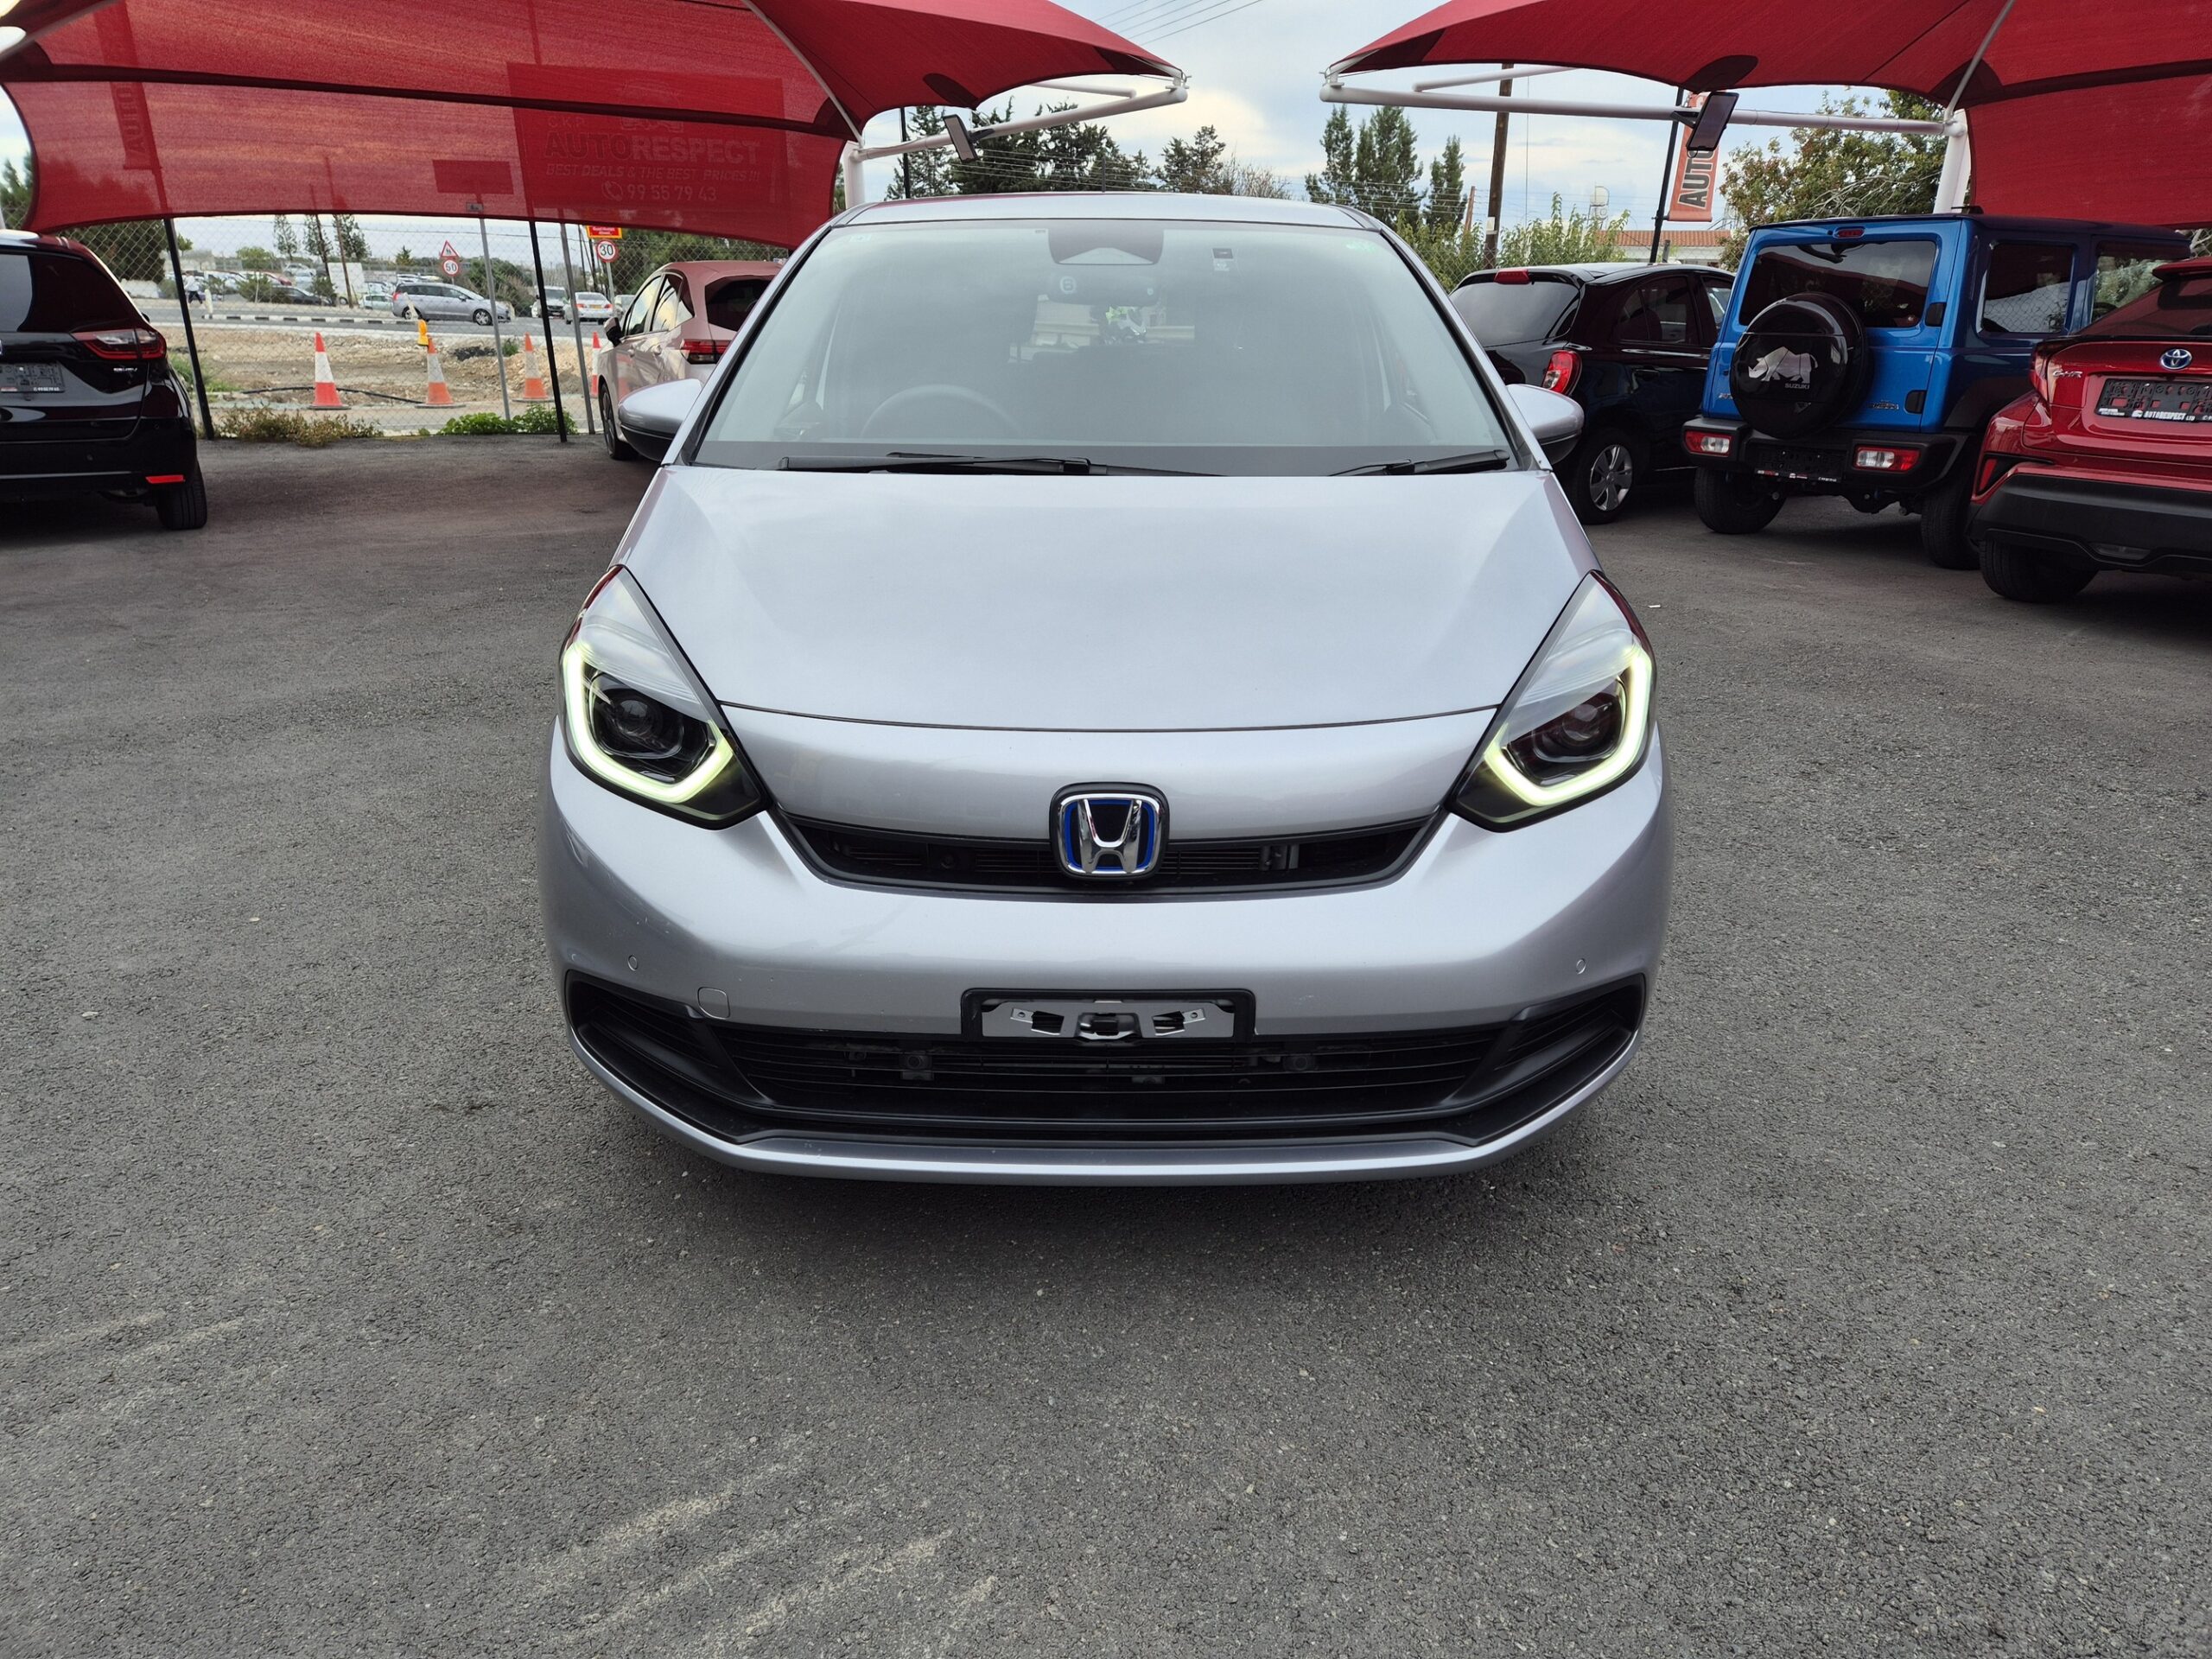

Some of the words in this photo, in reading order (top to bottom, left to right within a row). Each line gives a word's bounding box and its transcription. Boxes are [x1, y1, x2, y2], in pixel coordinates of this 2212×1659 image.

[543, 130, 761, 165] AUTORESPECT
[545, 164, 579, 176] BEST
[582, 165, 624, 178] DEALS
[627, 166, 637, 178] &
[640, 167, 664, 180] THE
[667, 168, 698, 181] BEST
[626, 184, 645, 200] 99
[651, 184, 670, 200] 55
[675, 185, 694, 201] 79
[698, 186, 717, 202] 43
[600, 244, 613, 256] 30
[445, 263, 457, 271] 50
